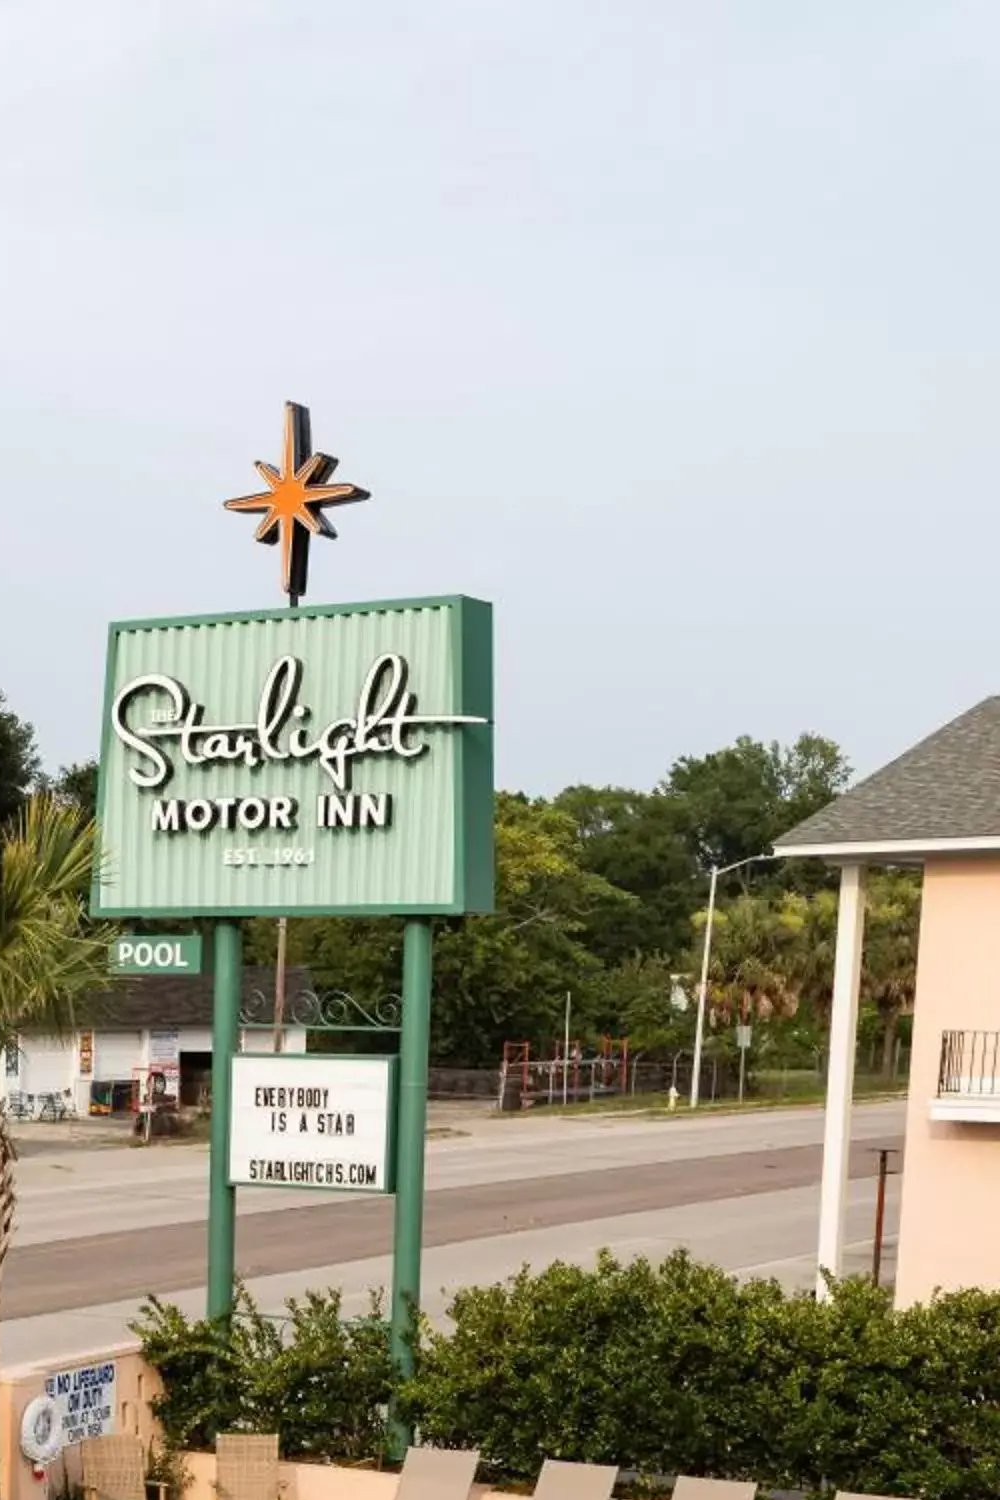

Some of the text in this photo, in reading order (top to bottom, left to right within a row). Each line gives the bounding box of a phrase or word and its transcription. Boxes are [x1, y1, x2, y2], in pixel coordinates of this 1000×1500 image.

[112, 654, 488, 788] Starlight
[152, 794, 387, 831] MOTOR INN
[118, 942, 188, 967] POOL
[255, 1087, 329, 1109] EVERYBODY
[271, 1112, 355, 1135] IS A STAR
[249, 1160, 377, 1185] STARLIGHTCHS.COM
[57, 1375, 71, 1394] NO
[73, 1364, 115, 1391] LIFEGUARD
